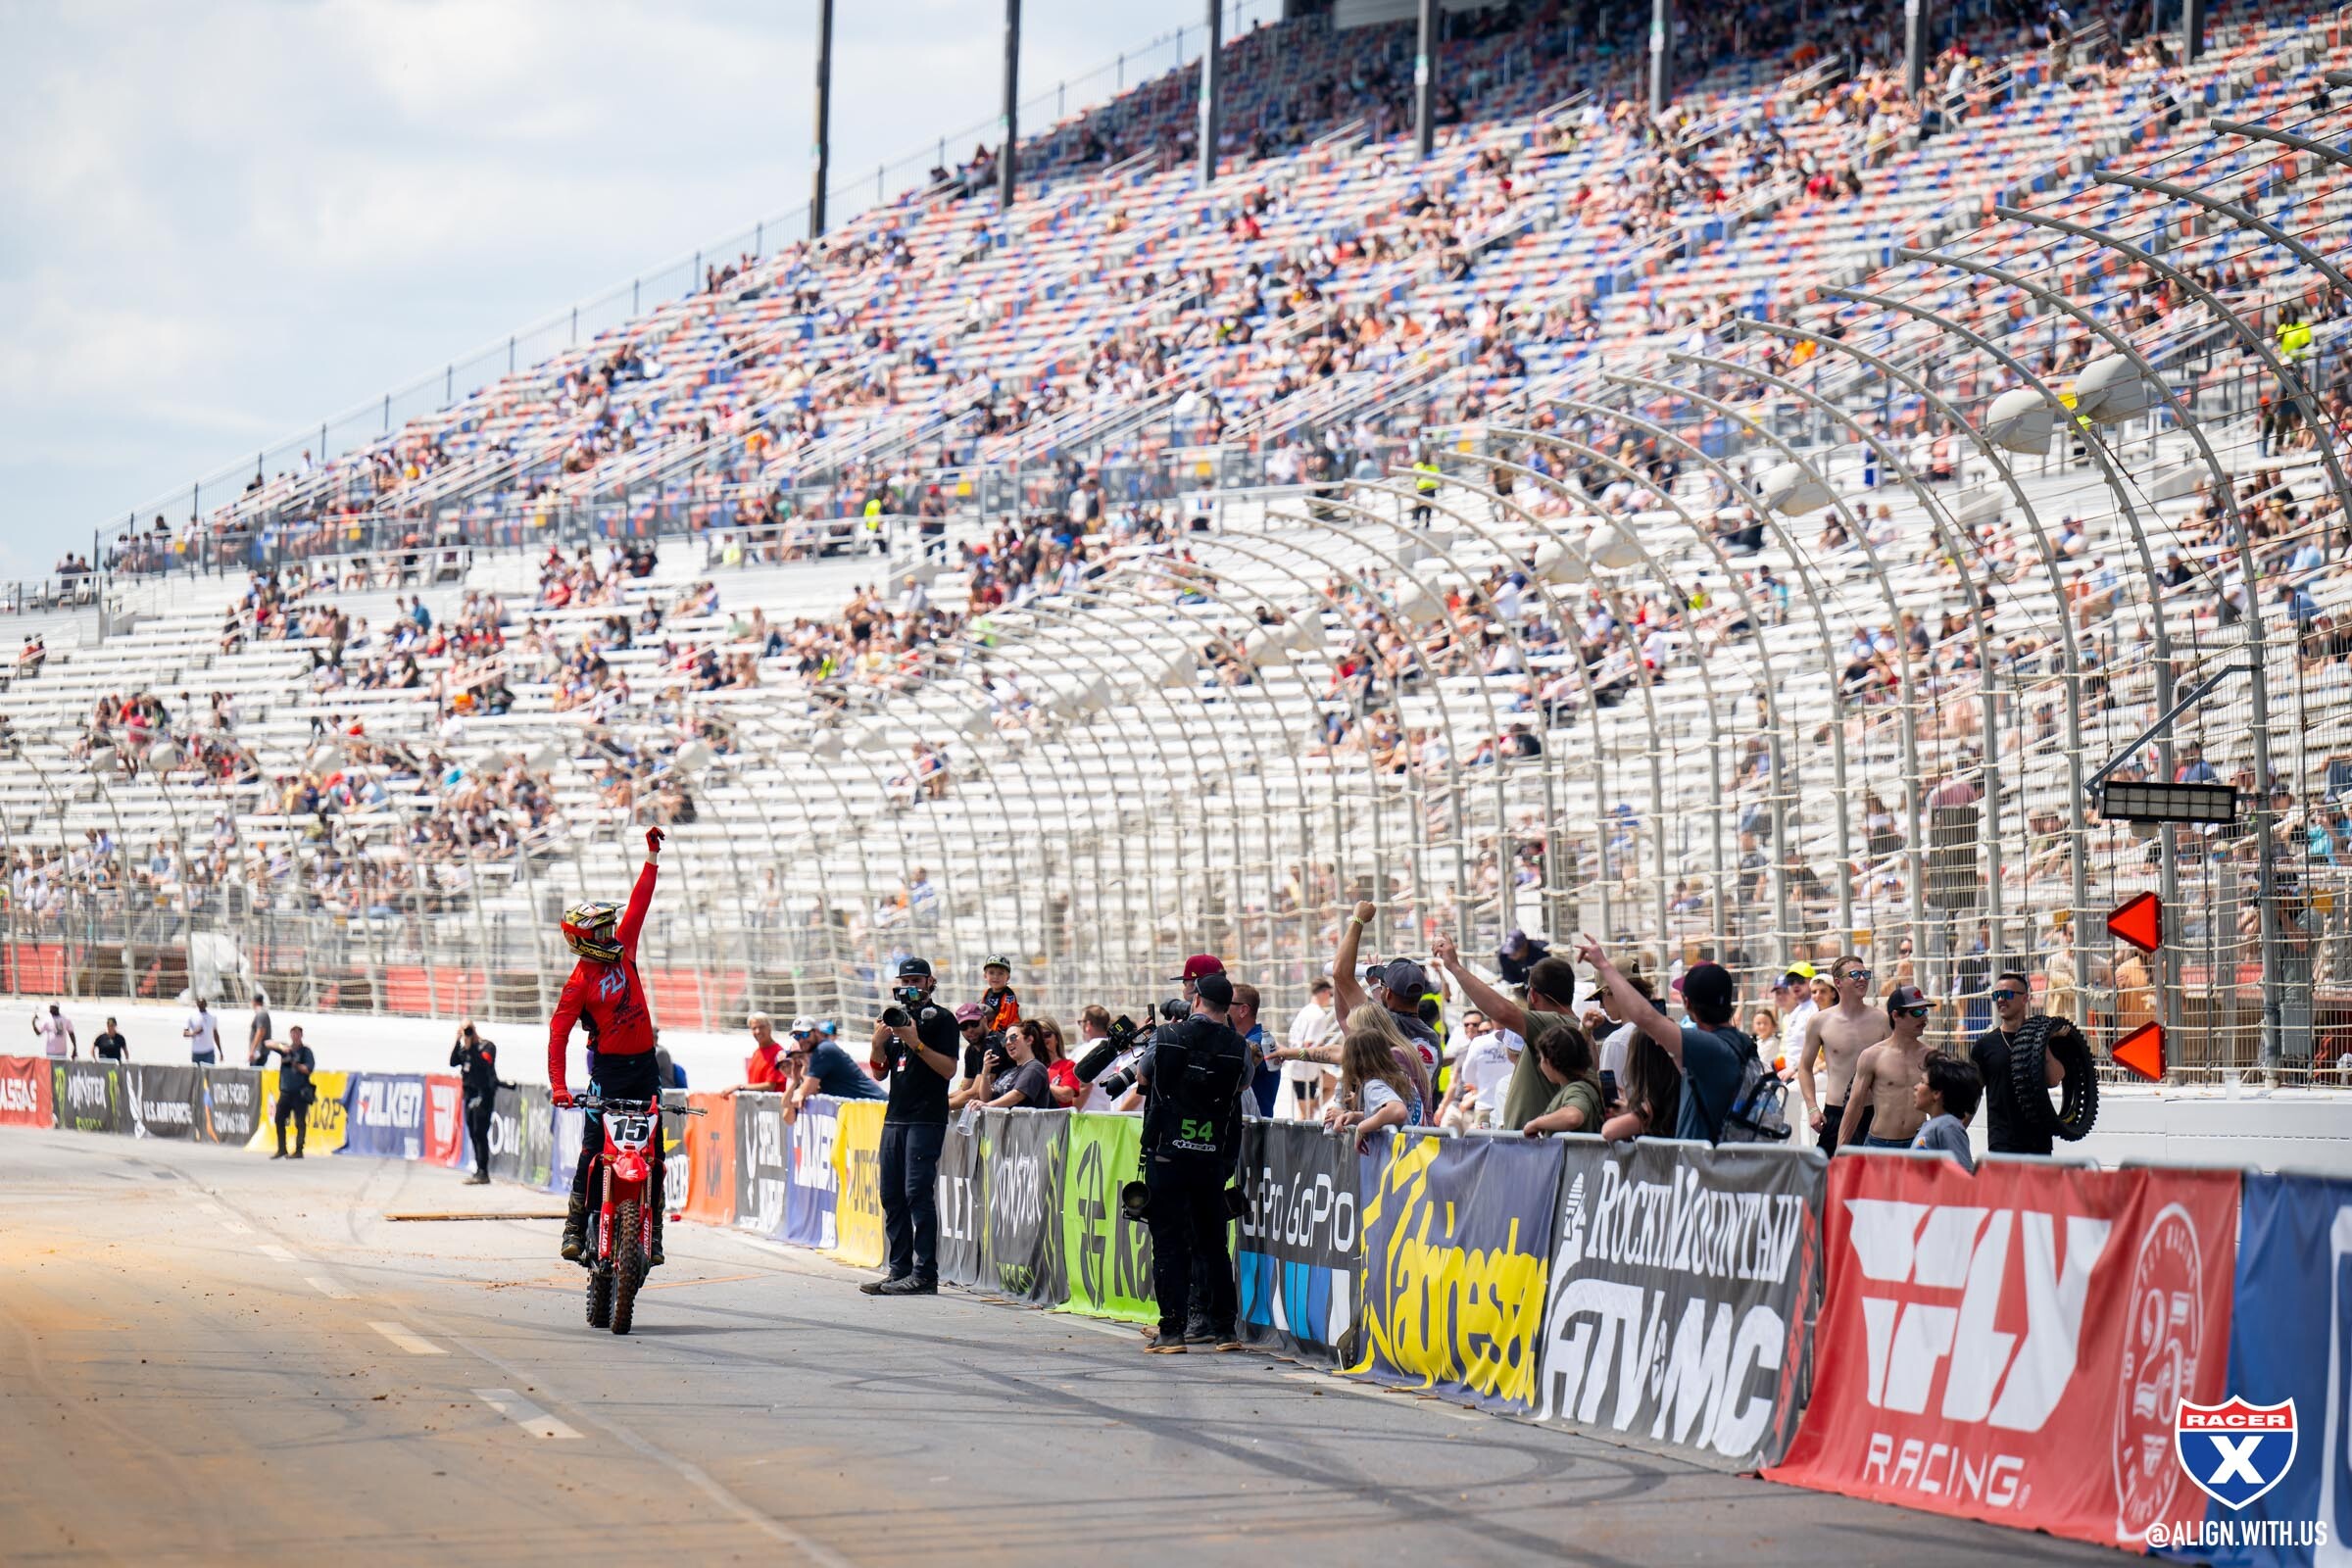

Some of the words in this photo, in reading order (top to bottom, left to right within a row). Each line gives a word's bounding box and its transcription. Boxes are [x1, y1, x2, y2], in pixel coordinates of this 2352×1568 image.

[578, 945, 616, 960] ROCKSTAR
[599, 965, 626, 1003] FLY
[0, 1078, 37, 1113] ASGAS
[68, 1068, 107, 1111] MONSTER
[357, 1081, 423, 1128] FALKEN
[612, 1117, 650, 1142] 15
[1181, 1118, 1213, 1142] 54
[990, 1138, 1042, 1239] MONSTER
[1285, 1172, 1355, 1252] GoPro
[1843, 1199, 2112, 1433] FLY
[1863, 1433, 2025, 1507] RACING
